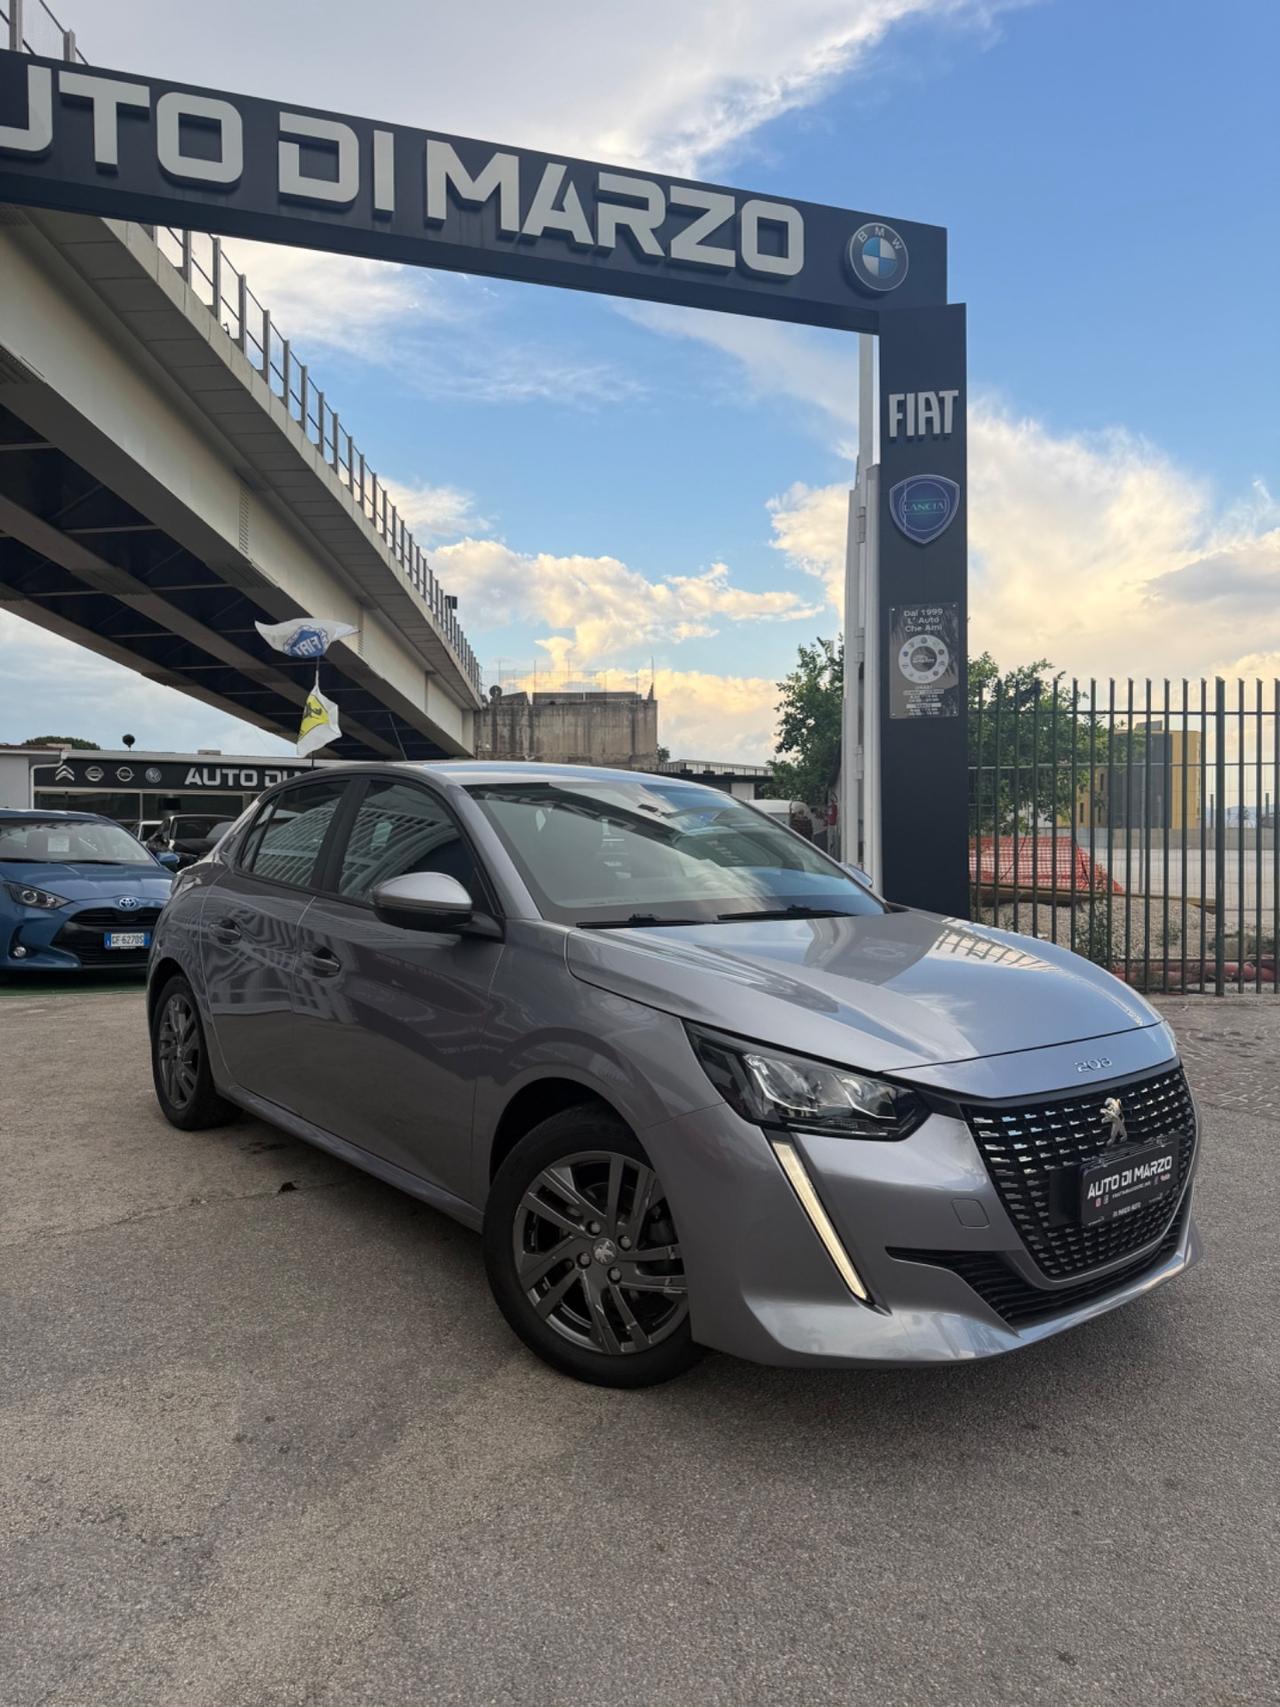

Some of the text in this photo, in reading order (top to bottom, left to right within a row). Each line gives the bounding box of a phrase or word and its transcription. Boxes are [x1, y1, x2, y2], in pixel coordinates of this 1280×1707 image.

[278, 111, 395, 212] DI
[426, 139, 804, 277] MARZO
[857, 226, 902, 249] BMW
[888, 389, 960, 438] FIAT
[904, 502, 945, 513] LANCIA
[903, 608, 943, 617] Dal 1999
[184, 767, 258, 787] AUTO
[1074, 1057, 1112, 1072] 208
[1087, 1174, 1119, 1200] AUTO
[1121, 1169, 1133, 1187] DI
[1133, 1155, 1172, 1182] MARZO
